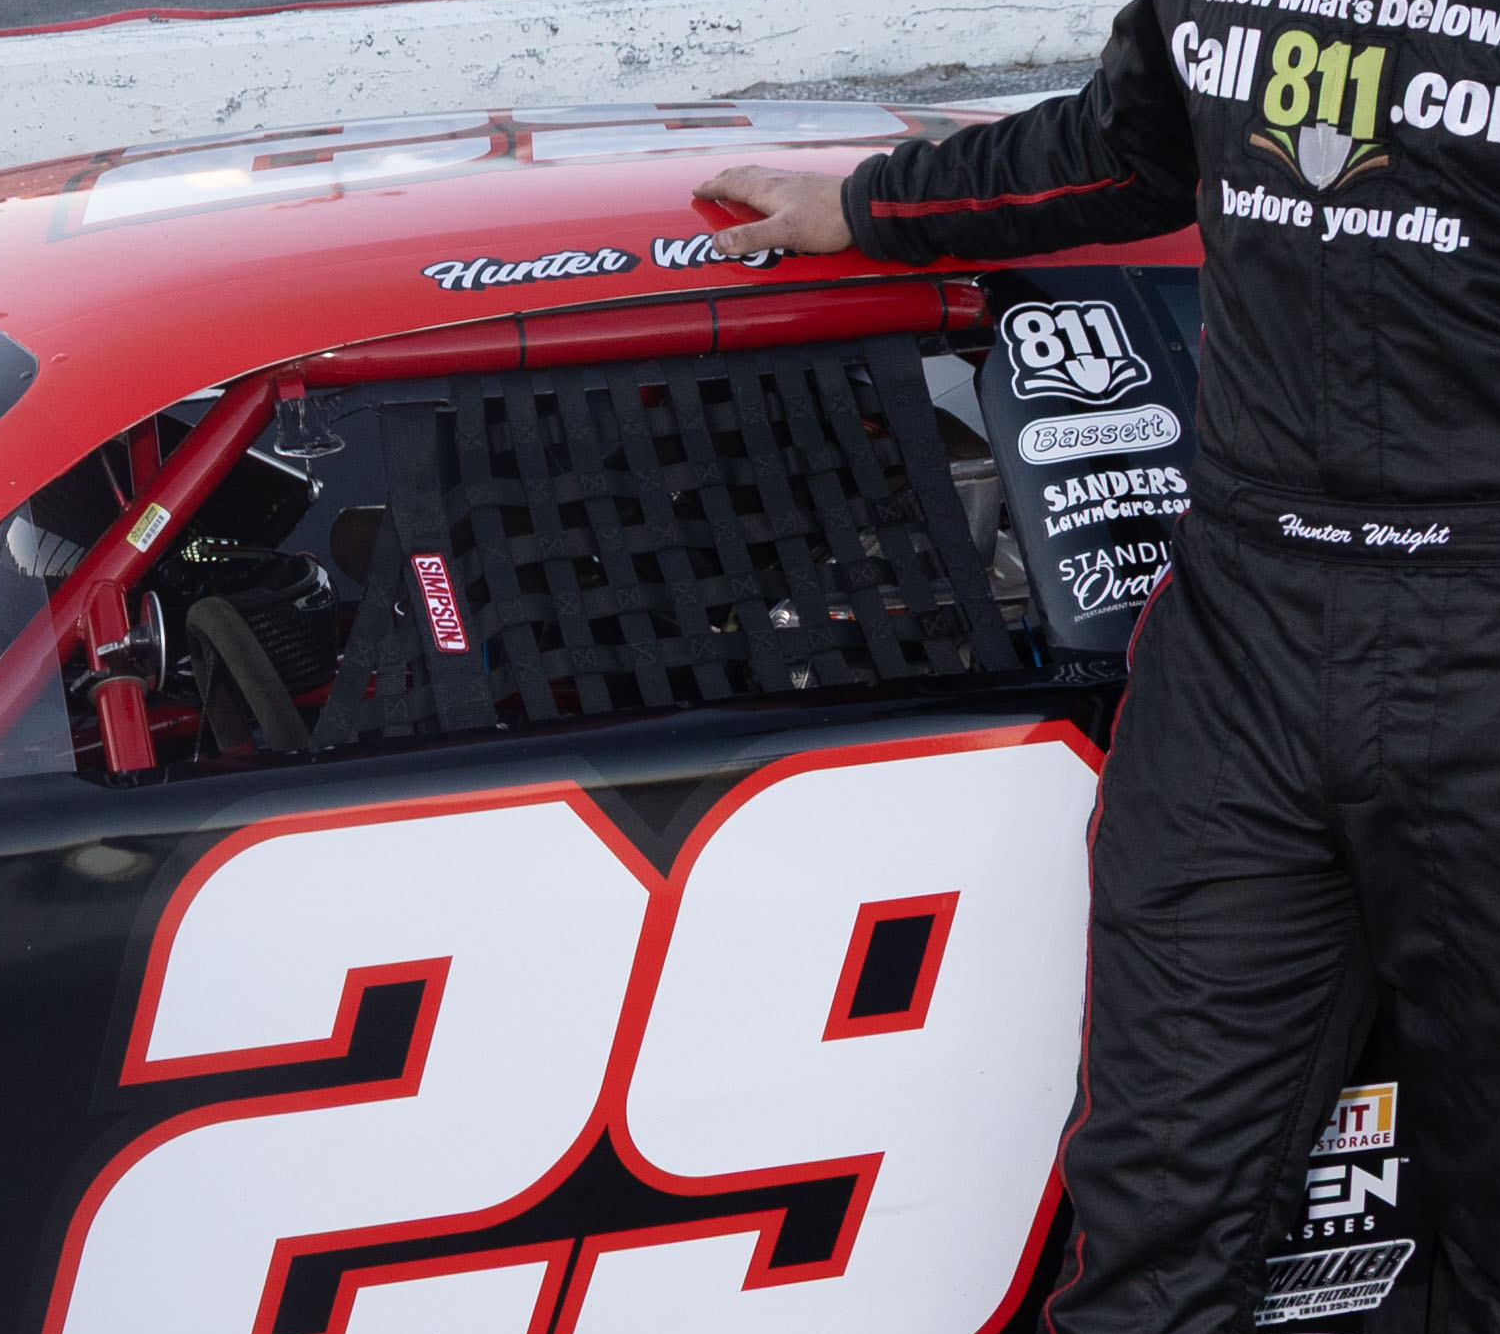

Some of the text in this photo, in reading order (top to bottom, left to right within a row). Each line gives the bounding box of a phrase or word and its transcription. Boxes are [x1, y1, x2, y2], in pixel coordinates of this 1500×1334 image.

[1171, 20, 1262, 101] Call
[1221, 179, 1470, 253] before you dig.
[423, 247, 629, 290] Hunter
[1012, 308, 1123, 369] 811
[1033, 415, 1165, 453] Bassett
[1043, 467, 1188, 514] SANDERS
[1278, 514, 1450, 547] Hunter Wright
[1058, 540, 1172, 581] STANDI
[416, 556, 463, 646] SIMPSON
[1316, 1132, 1391, 1152] STORAGE
[1305, 1158, 1399, 1219] EN
[1314, 1281, 1388, 1305] FILTRATION
